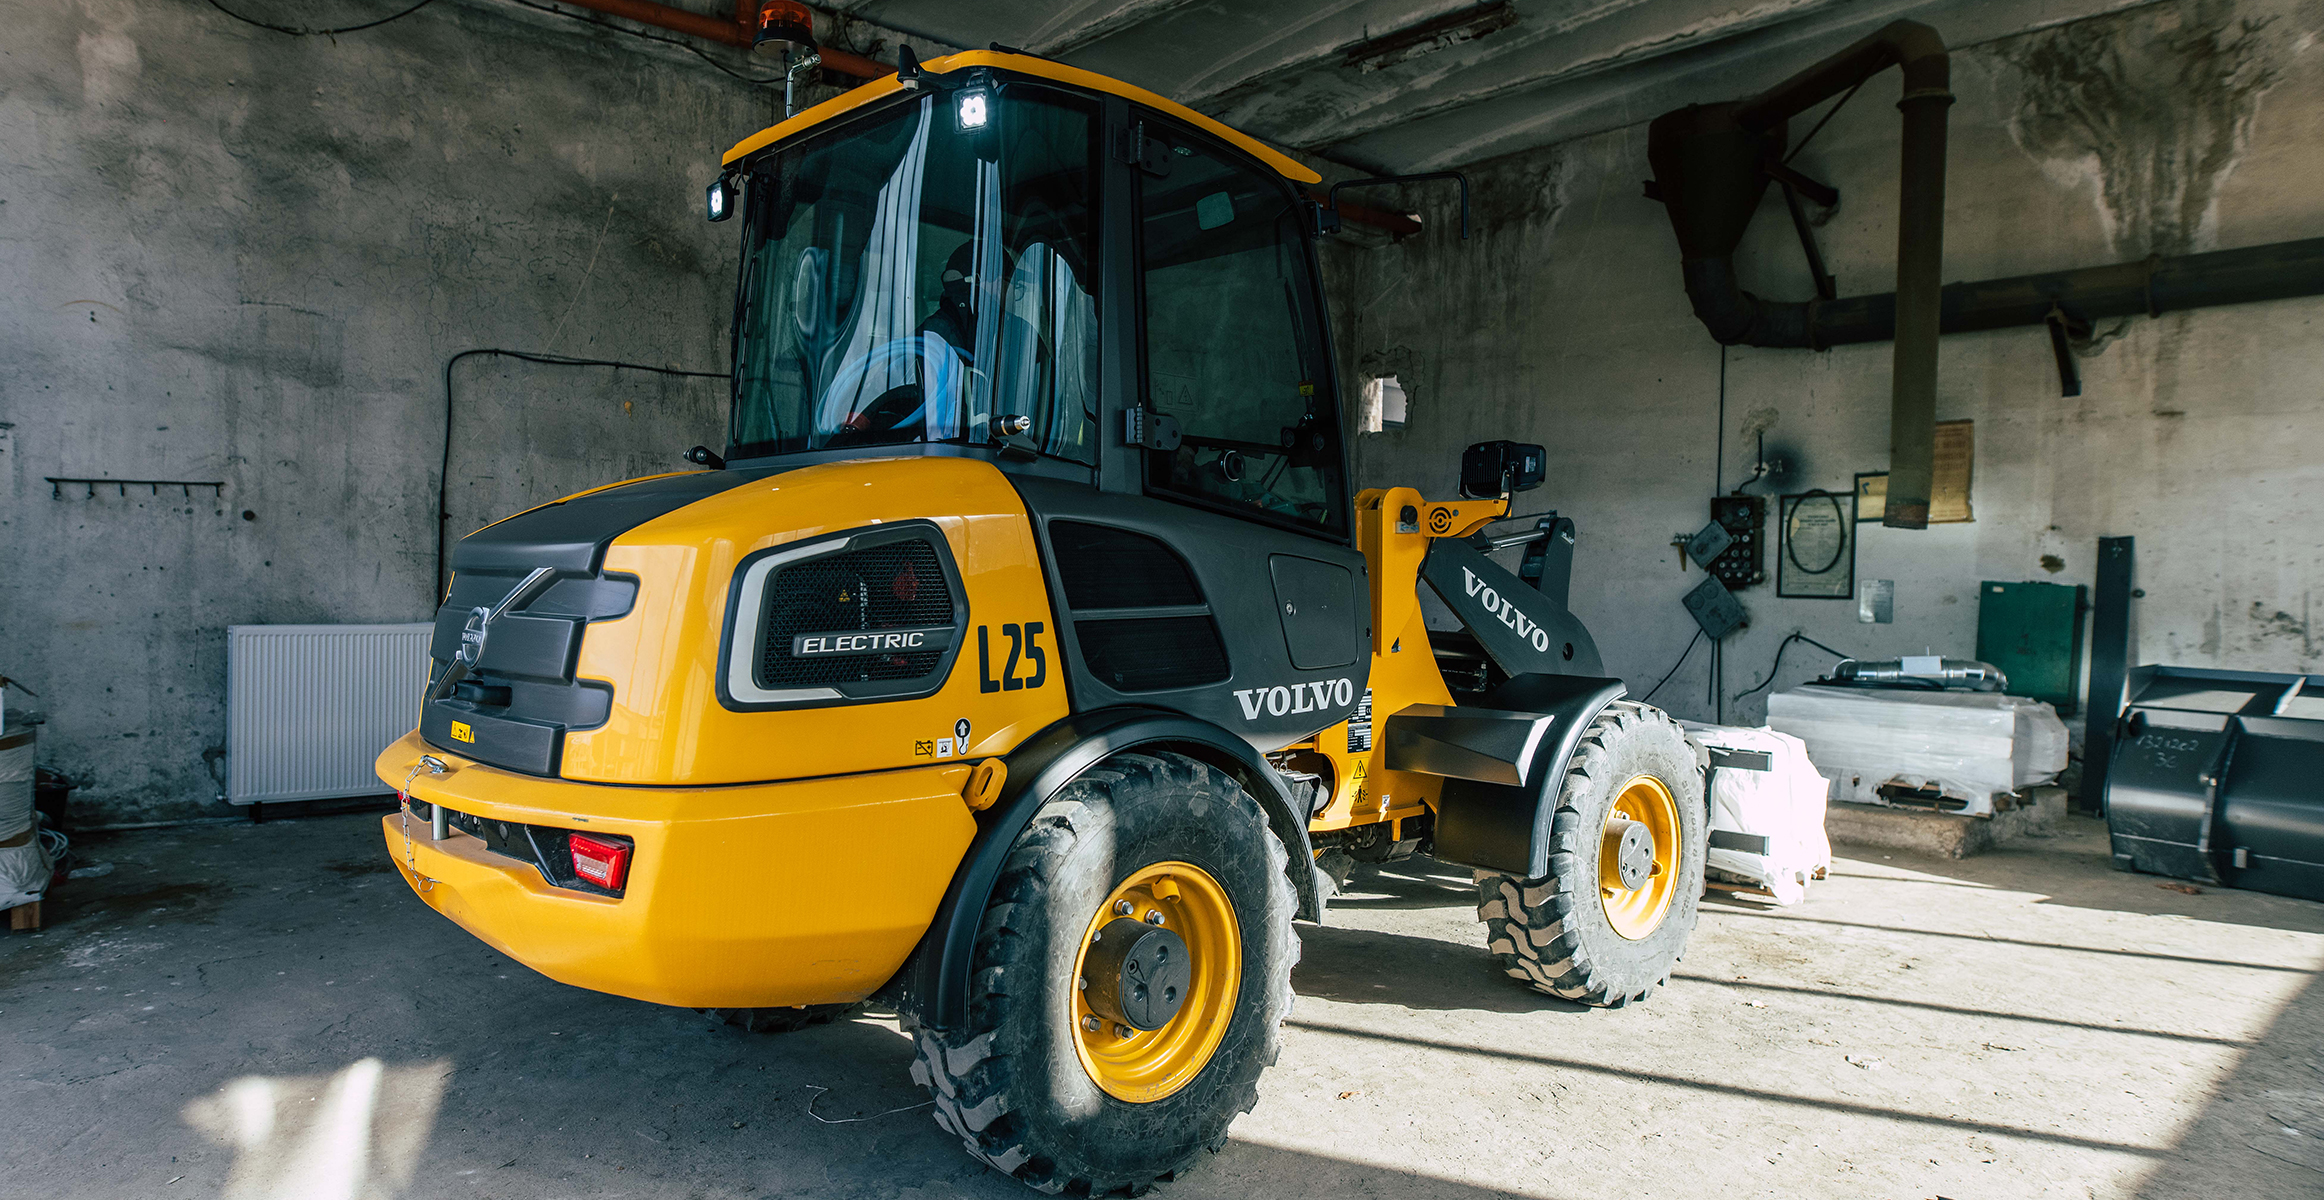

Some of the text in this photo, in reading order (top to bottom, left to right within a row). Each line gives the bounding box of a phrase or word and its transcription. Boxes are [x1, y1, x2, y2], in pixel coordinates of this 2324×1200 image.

[1462, 565, 1549, 652] VOLVO
[802, 632, 924, 654] ELECTRIC
[977, 621, 1047, 694] L25
[1233, 677, 1353, 720] VOLVO
